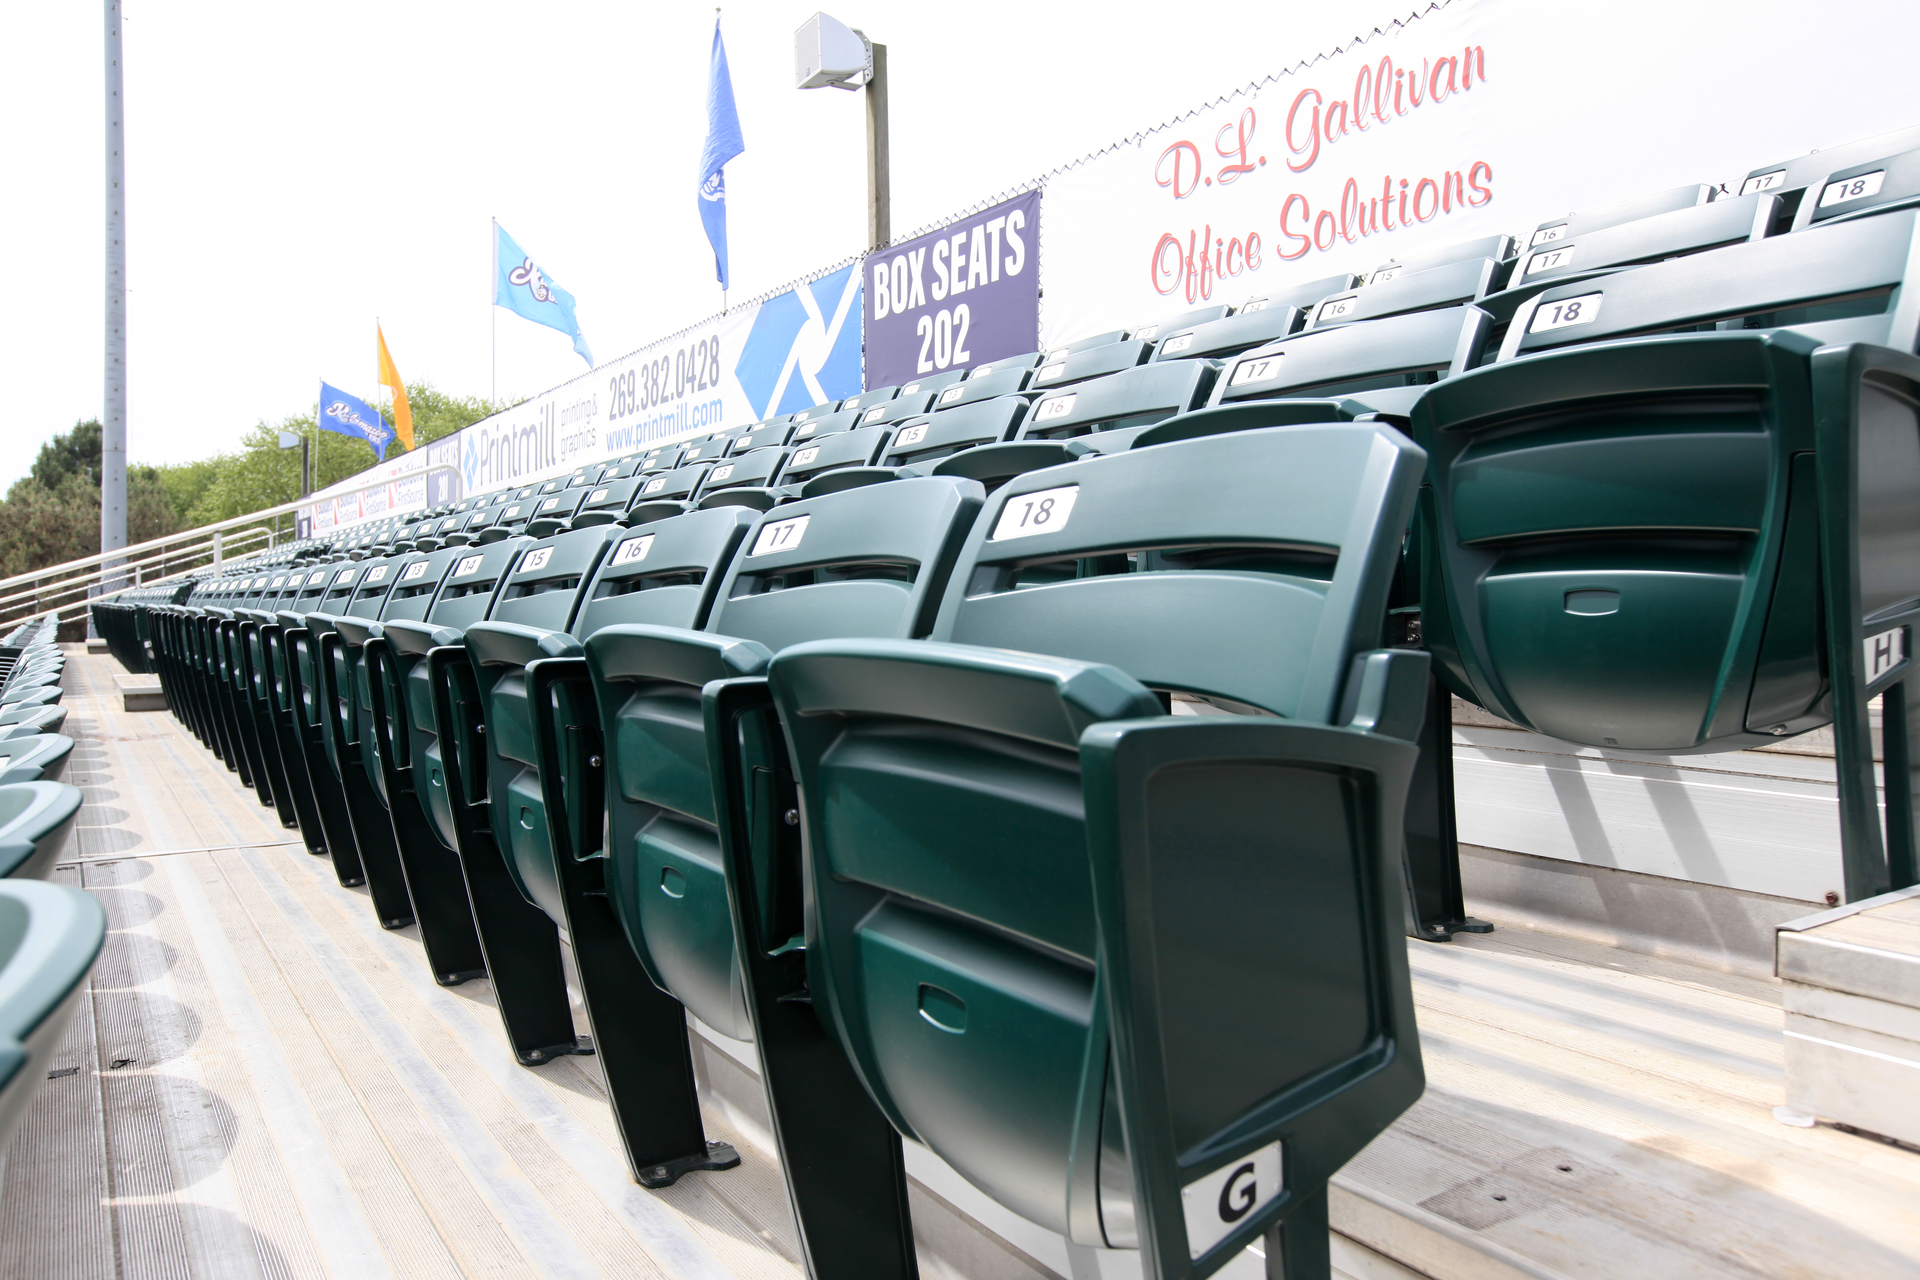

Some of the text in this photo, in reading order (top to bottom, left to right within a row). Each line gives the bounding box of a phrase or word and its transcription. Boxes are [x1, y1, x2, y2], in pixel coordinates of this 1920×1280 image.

[1154, 45, 1486, 199] D.L. Gallivan
[1755, 176, 1773, 190] 17
[1839, 179, 1865, 199] 18
[1150, 160, 1492, 303] Office Solutions
[1542, 229, 1556, 240] 16
[873, 209, 1025, 321] BOX SEATS
[1542, 252, 1561, 268] 17
[1380, 271, 1393, 281] 15
[1330, 302, 1345, 315] 16
[1552, 301, 1582, 324] 18
[916, 303, 971, 374] 202
[1171, 339, 1183, 350] 15
[1248, 361, 1270, 379] 17
[608, 334, 720, 422] 269.382.0428
[948, 390, 958, 399] 13
[1047, 400, 1064, 414] 16
[605, 398, 723, 452] www.printmill.com
[905, 428, 919, 442] 15
[480, 400, 556, 487] Printmill
[561, 426, 597, 462] graphics
[800, 450, 812, 462] 14
[717, 467, 727, 478] 13
[651, 480, 661, 490] 12
[1019, 498, 1056, 527] 18
[769, 523, 796, 546] 17
[623, 541, 644, 559] 16
[463, 559, 477, 572] 14
[529, 552, 545, 567] 15
[312, 573, 321, 582] 10
[343, 571, 351, 580] 11
[372, 568, 383, 578] 12
[411, 565, 423, 576] 13
[1873, 633, 1891, 676] H
[1218, 1161, 1257, 1224] G
